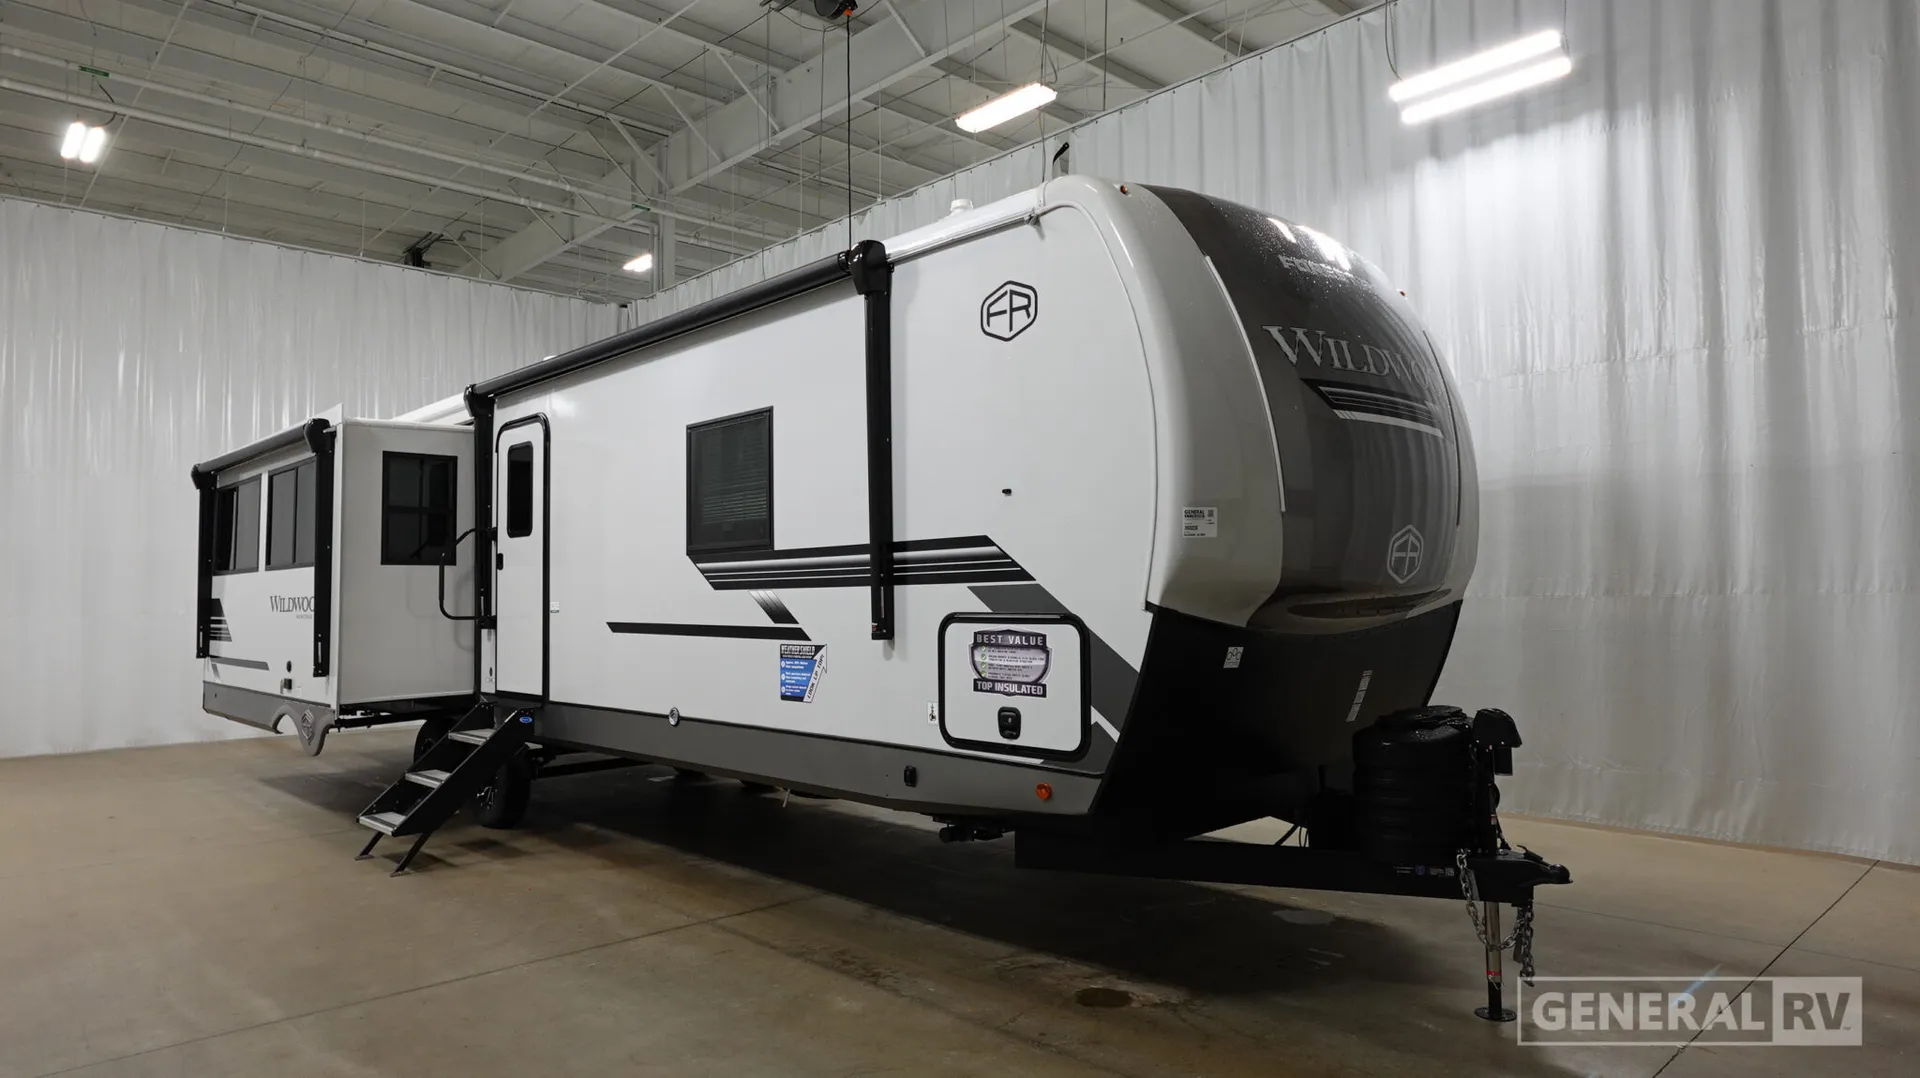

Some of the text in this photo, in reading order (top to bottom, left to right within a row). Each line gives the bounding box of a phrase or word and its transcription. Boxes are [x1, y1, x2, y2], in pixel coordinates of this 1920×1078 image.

[270, 596, 315, 612] WILDWOO
[976, 634, 1043, 645] BEST VALUE
[977, 681, 1043, 695] TOP INSULATED
